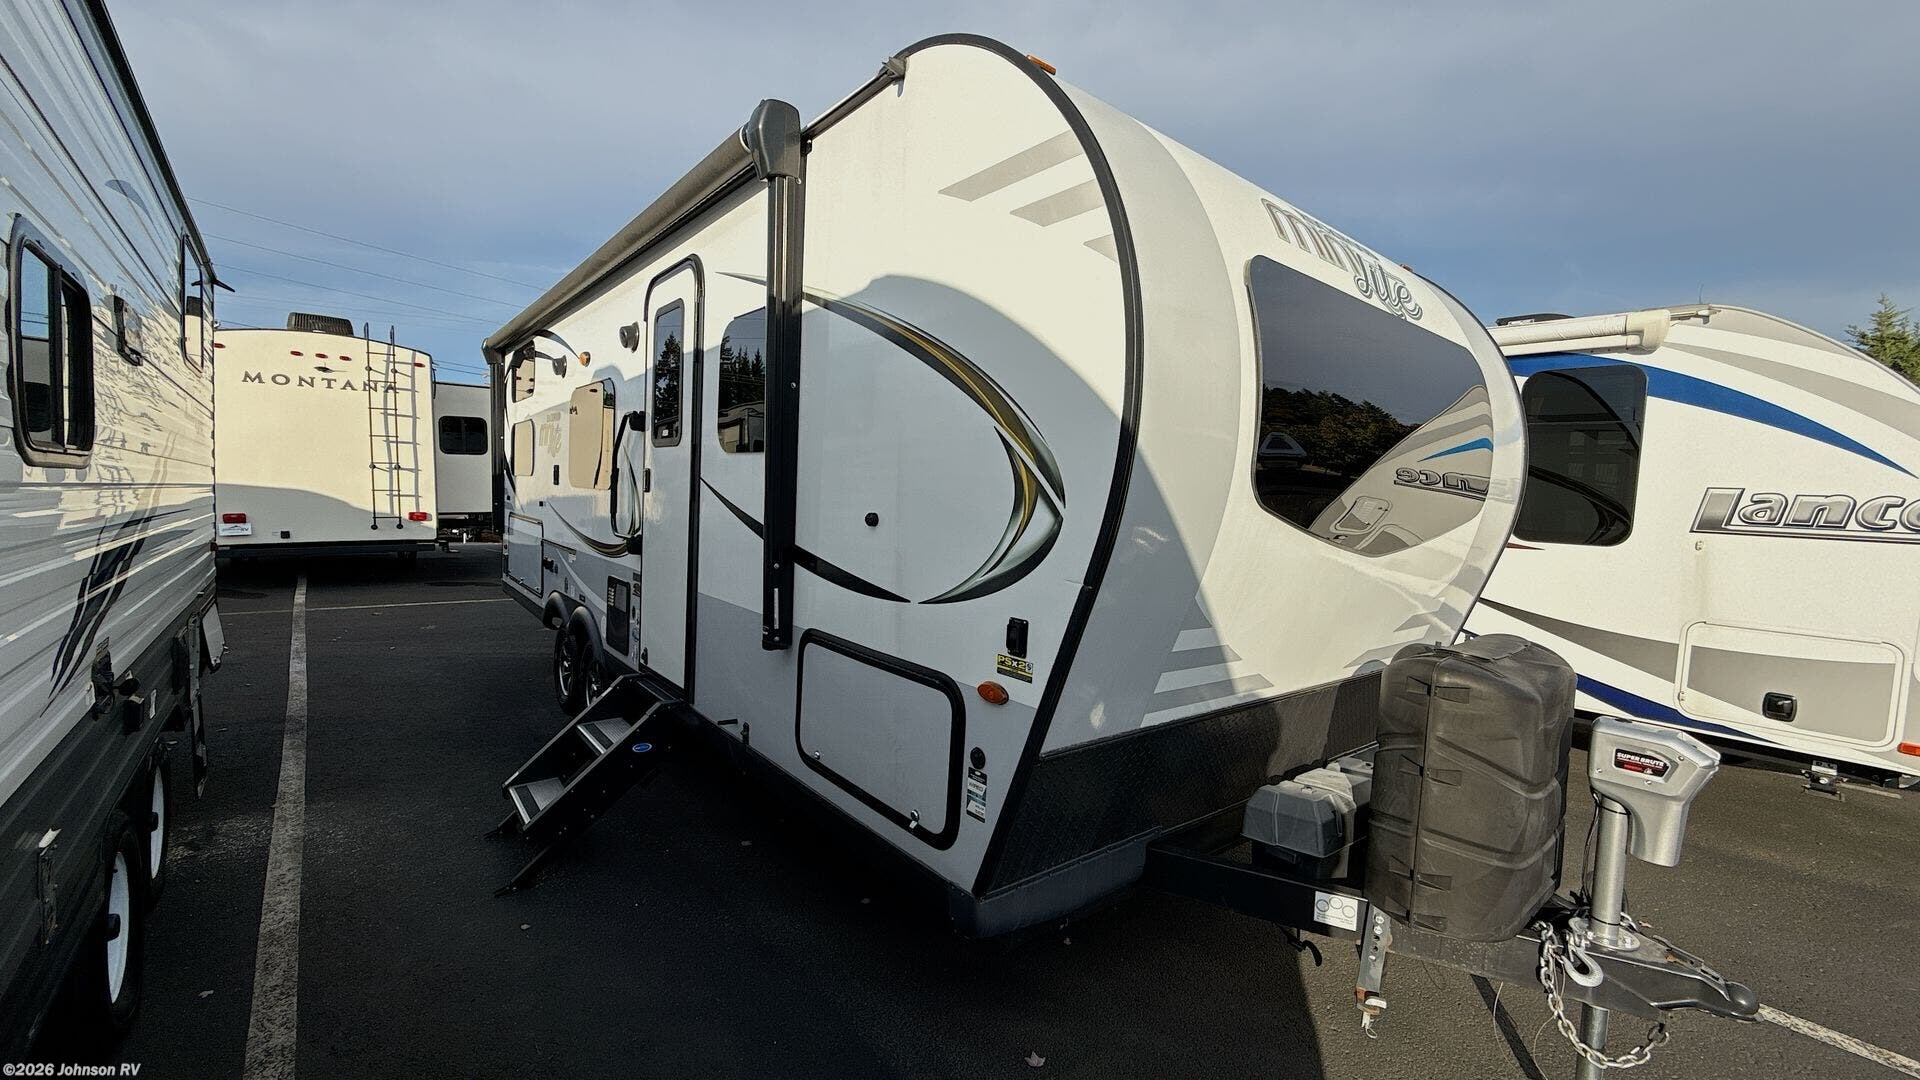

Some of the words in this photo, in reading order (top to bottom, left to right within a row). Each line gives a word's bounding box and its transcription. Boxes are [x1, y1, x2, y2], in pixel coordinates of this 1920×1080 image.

[241, 370, 400, 394] MONTANA
[1617, 752, 1640, 761] SUPER
[1641, 757, 1664, 766] BRUTE
